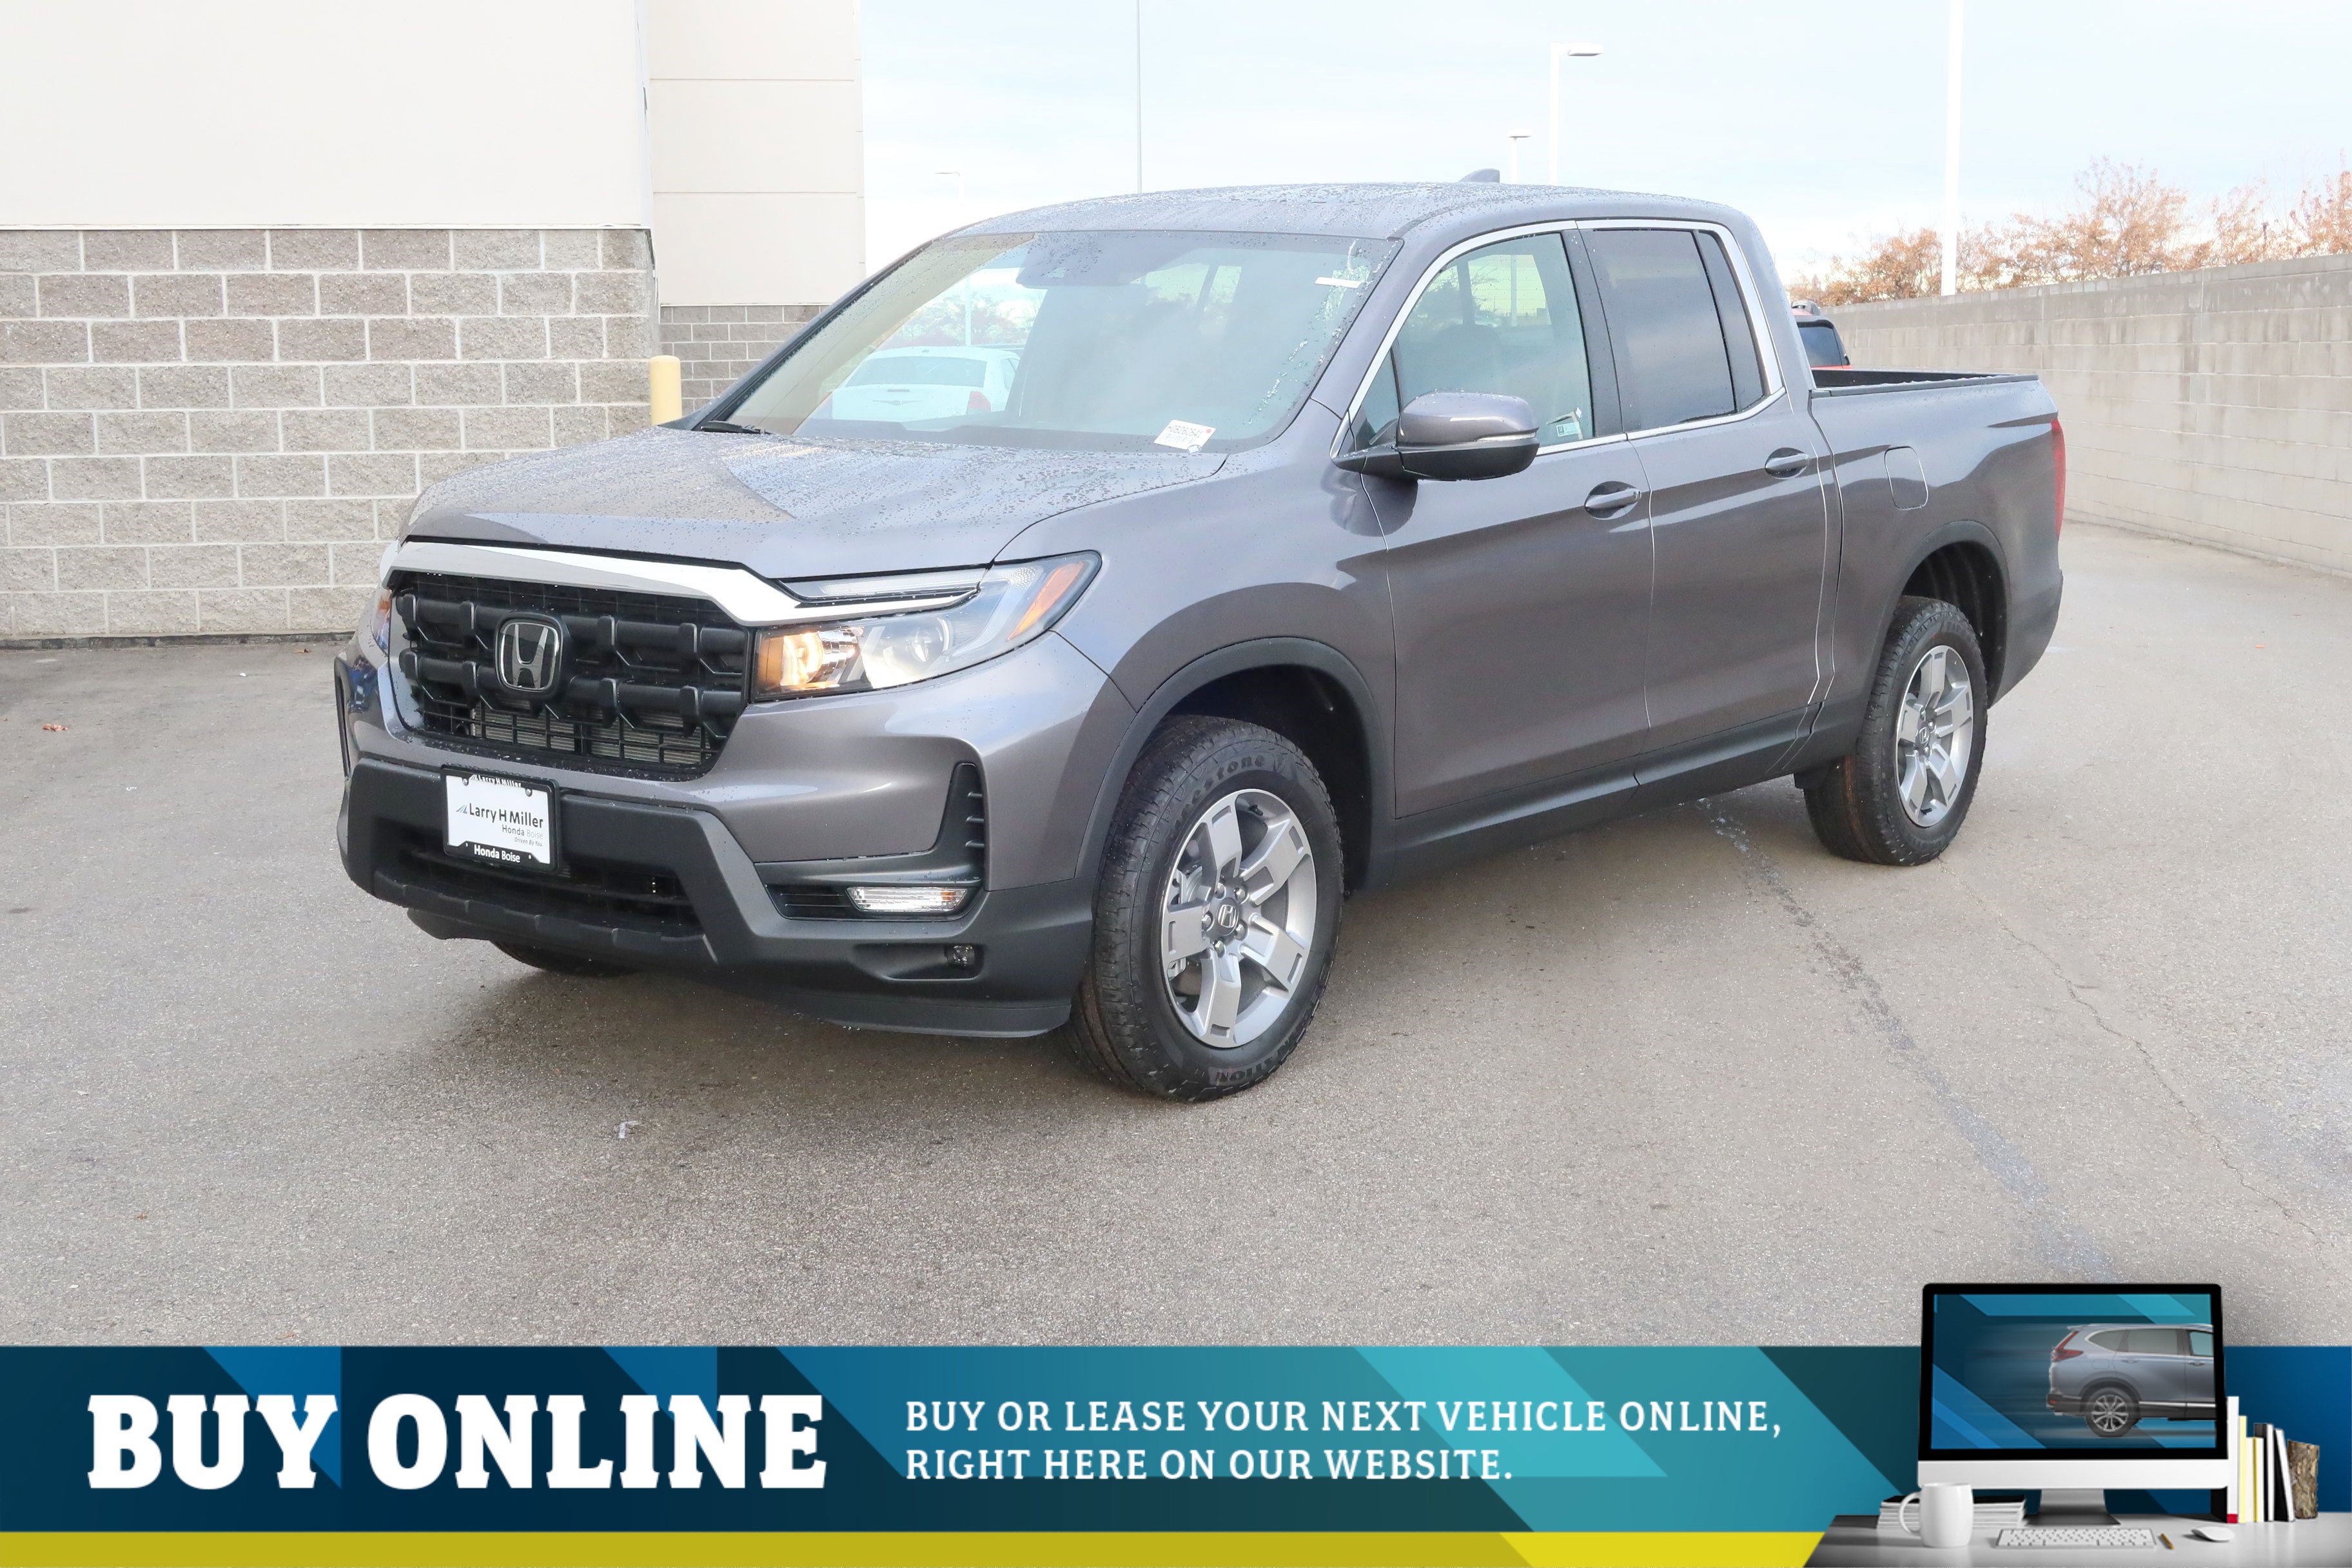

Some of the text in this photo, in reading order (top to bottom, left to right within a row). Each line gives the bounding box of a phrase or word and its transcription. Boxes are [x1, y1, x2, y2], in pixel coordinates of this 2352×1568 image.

[478, 774, 495, 785] Larry
[502, 779, 521, 788] Miller
[469, 803, 544, 828] Larry H Miller
[502, 824, 544, 839] Honda Boise
[474, 844, 521, 863] Honda Boise
